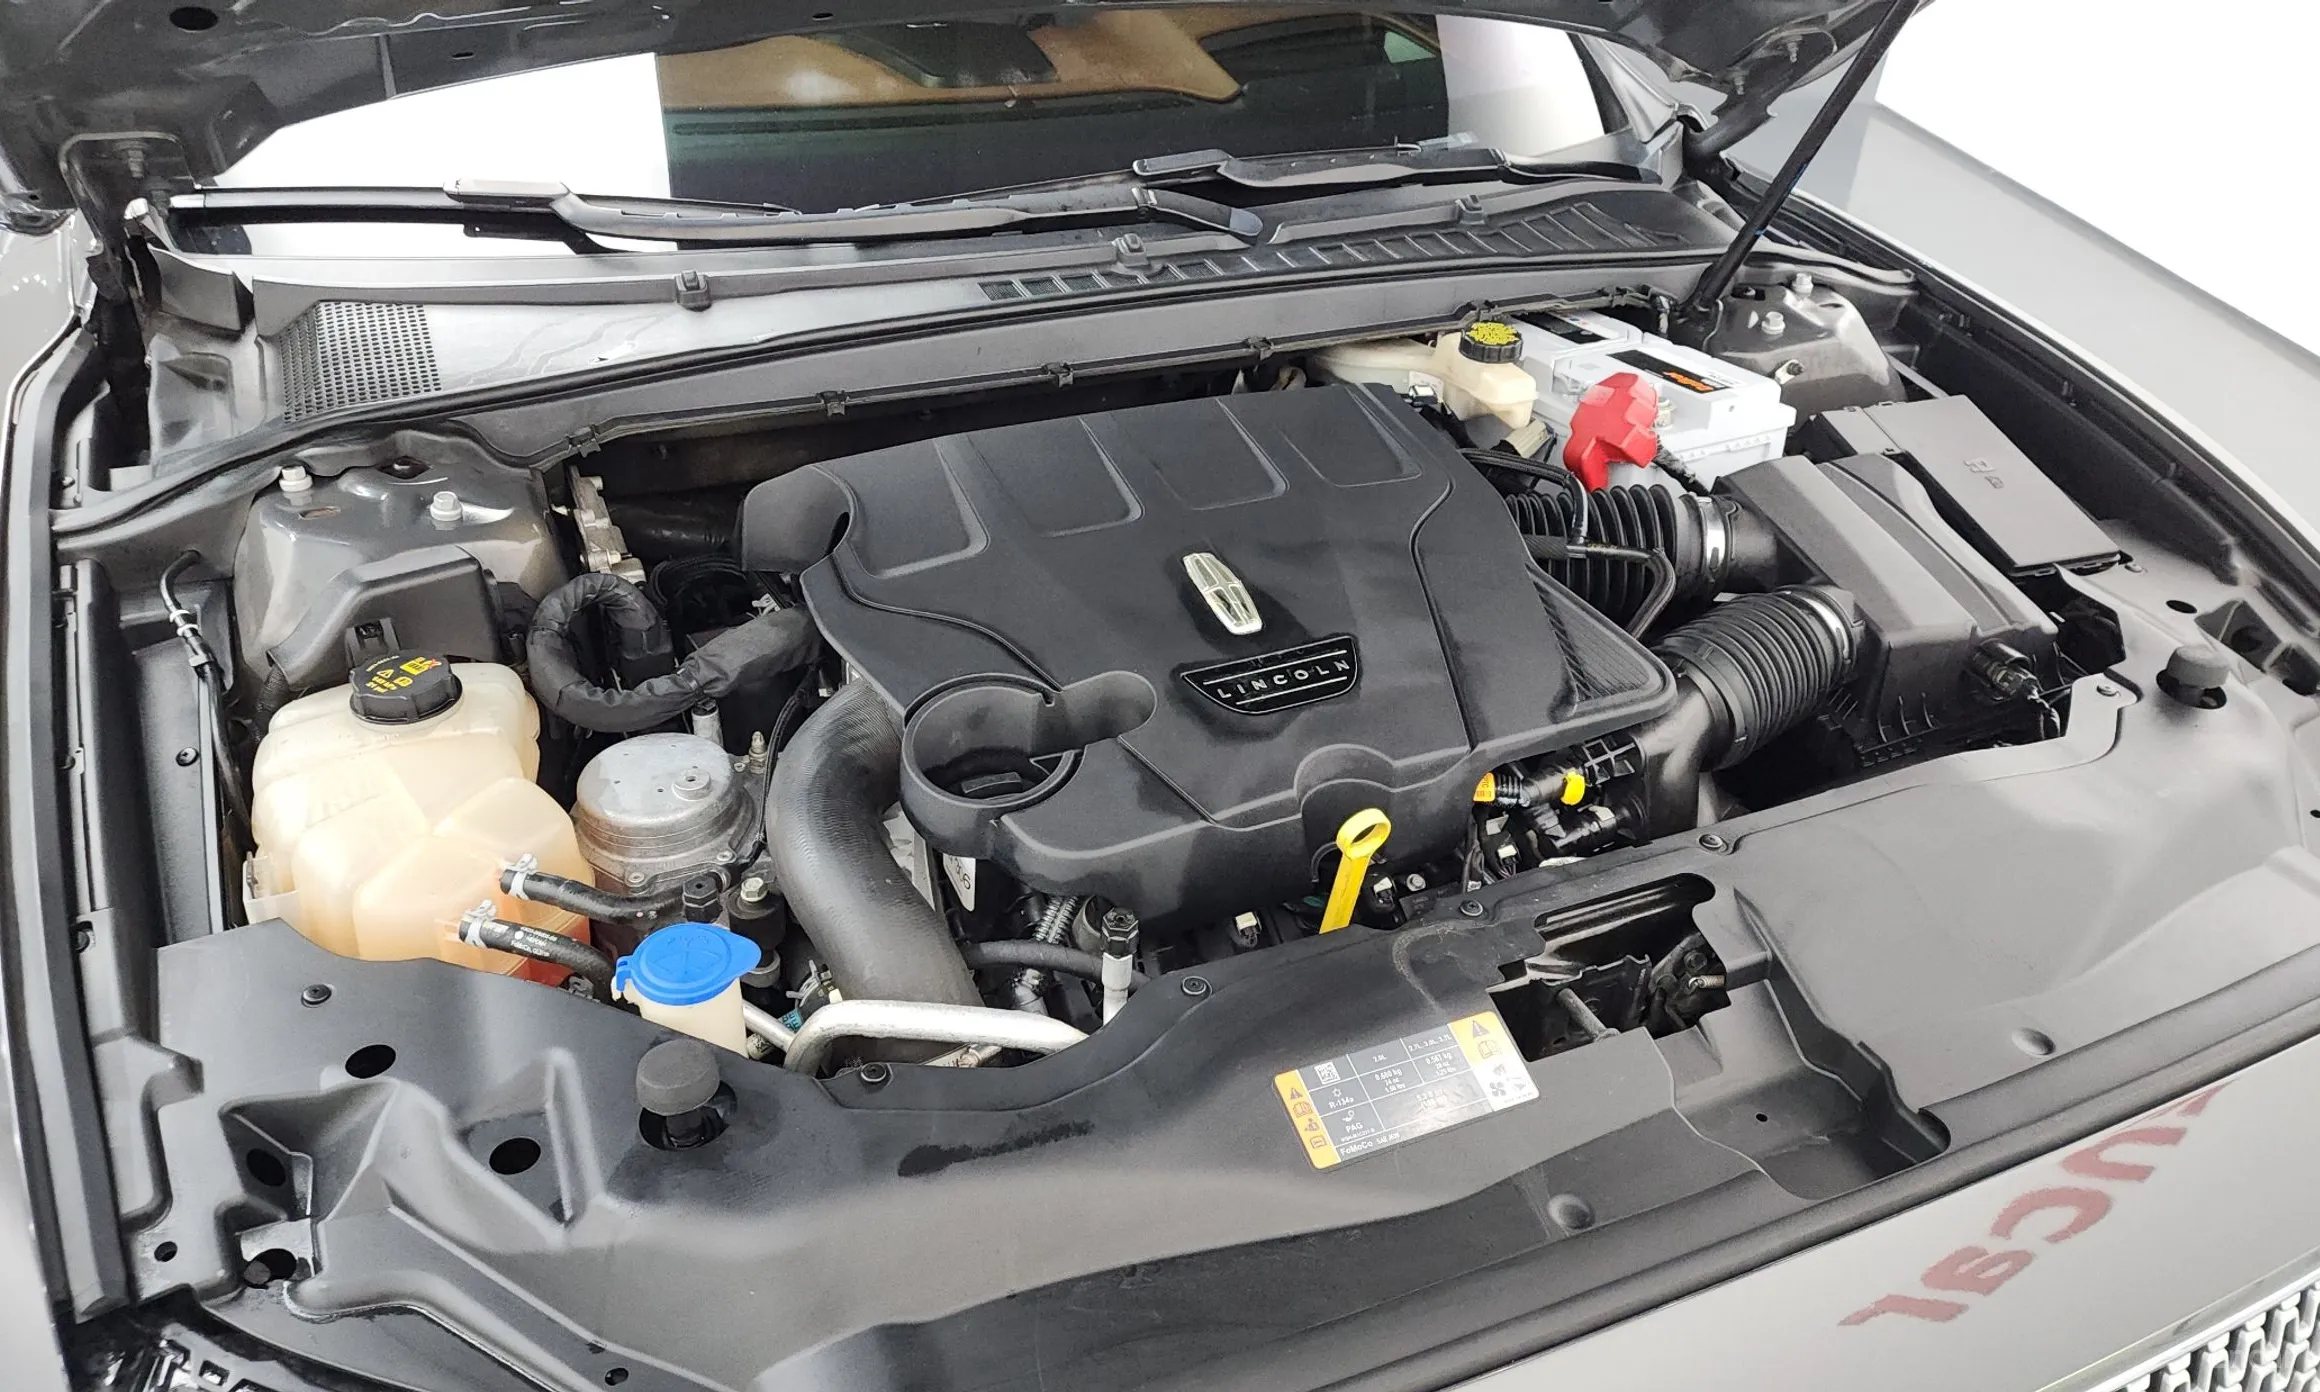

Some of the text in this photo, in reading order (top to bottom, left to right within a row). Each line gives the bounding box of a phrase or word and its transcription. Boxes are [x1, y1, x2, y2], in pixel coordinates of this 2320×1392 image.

[1217, 659, 1351, 699] LINCOLN
[1391, 1068, 1401, 1076] kg
[1329, 1097, 1354, 1108] R-134a
[1346, 1123, 1363, 1132] PAG
[1340, 1141, 1373, 1155] FoMoCo
